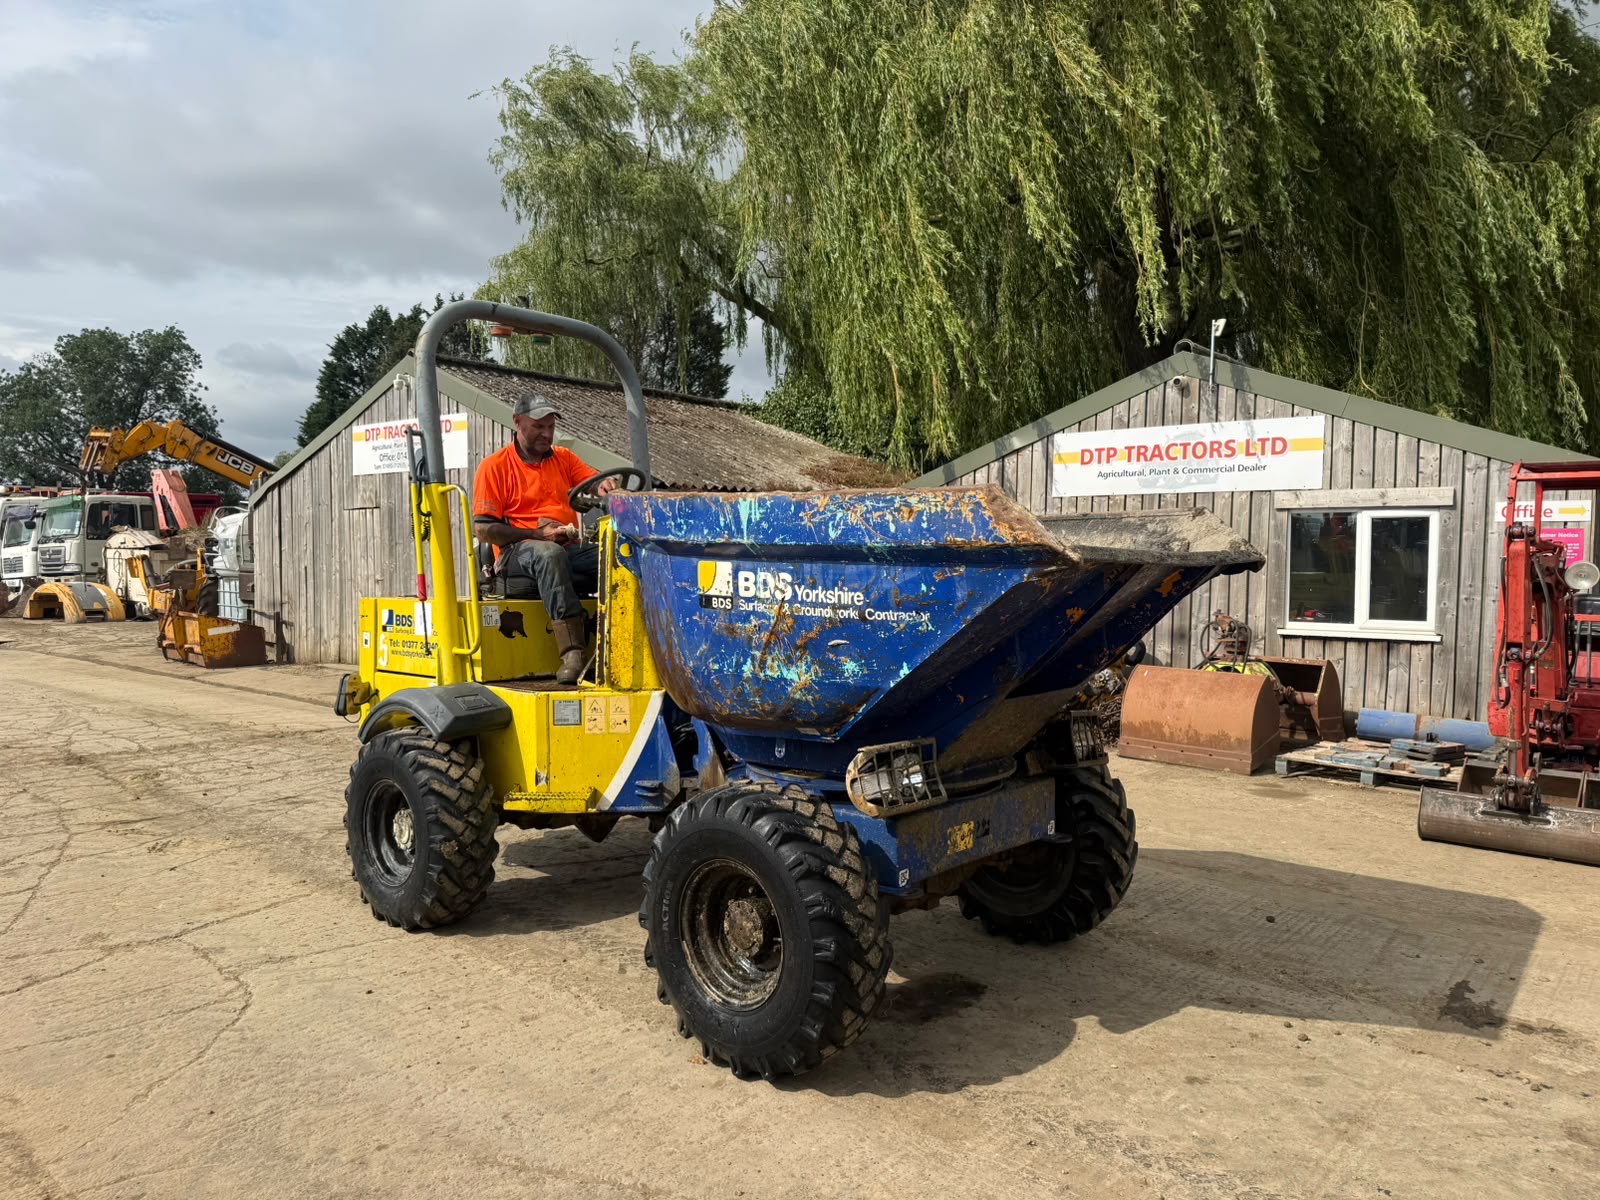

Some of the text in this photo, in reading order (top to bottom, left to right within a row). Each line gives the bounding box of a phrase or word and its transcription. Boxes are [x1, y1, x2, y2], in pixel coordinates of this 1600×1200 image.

[365, 428, 381, 442] DTP
[383, 423, 419, 440] TRACO
[1080, 436, 1288, 466] DTP TRACTORS LTD
[217, 452, 254, 475] JCB
[1097, 463, 1267, 480] Agricultural, Plant & Commercial Dealer
[737, 570, 864, 606] BDS Yorkshire
[712, 597, 732, 609] BDS
[782, 603, 790, 615] &
[395, 615, 413, 627] BDS
[379, 633, 388, 667] 5
